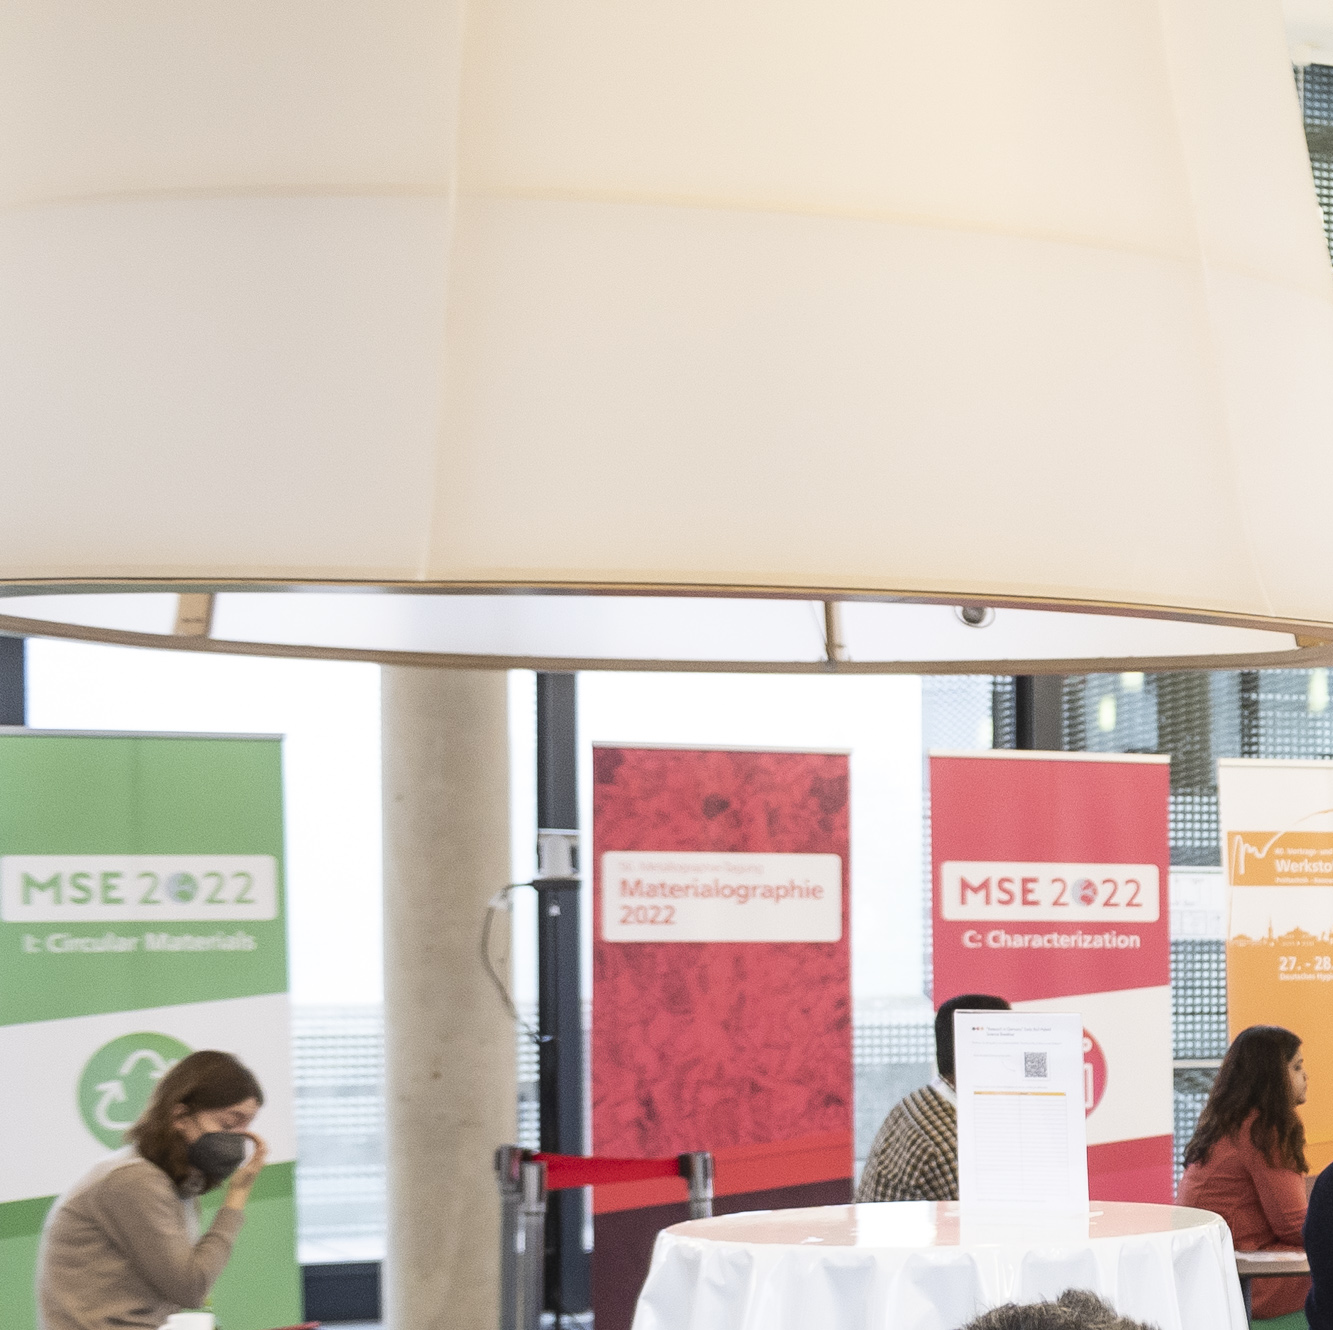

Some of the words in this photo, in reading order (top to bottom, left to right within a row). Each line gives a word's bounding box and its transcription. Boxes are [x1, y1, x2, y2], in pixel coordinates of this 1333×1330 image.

[21, 871, 125, 906] MSE
[137, 871, 256, 905] 2022
[619, 879, 825, 905] Materialographie
[960, 876, 1041, 906] MSE
[1051, 878, 1143, 908] 2022
[619, 905, 676, 925] 2022
[47, 933, 138, 952] Circular
[145, 931, 257, 951] Materials
[986, 928, 1142, 949] Characterization
[1279, 955, 1302, 971] 27.
